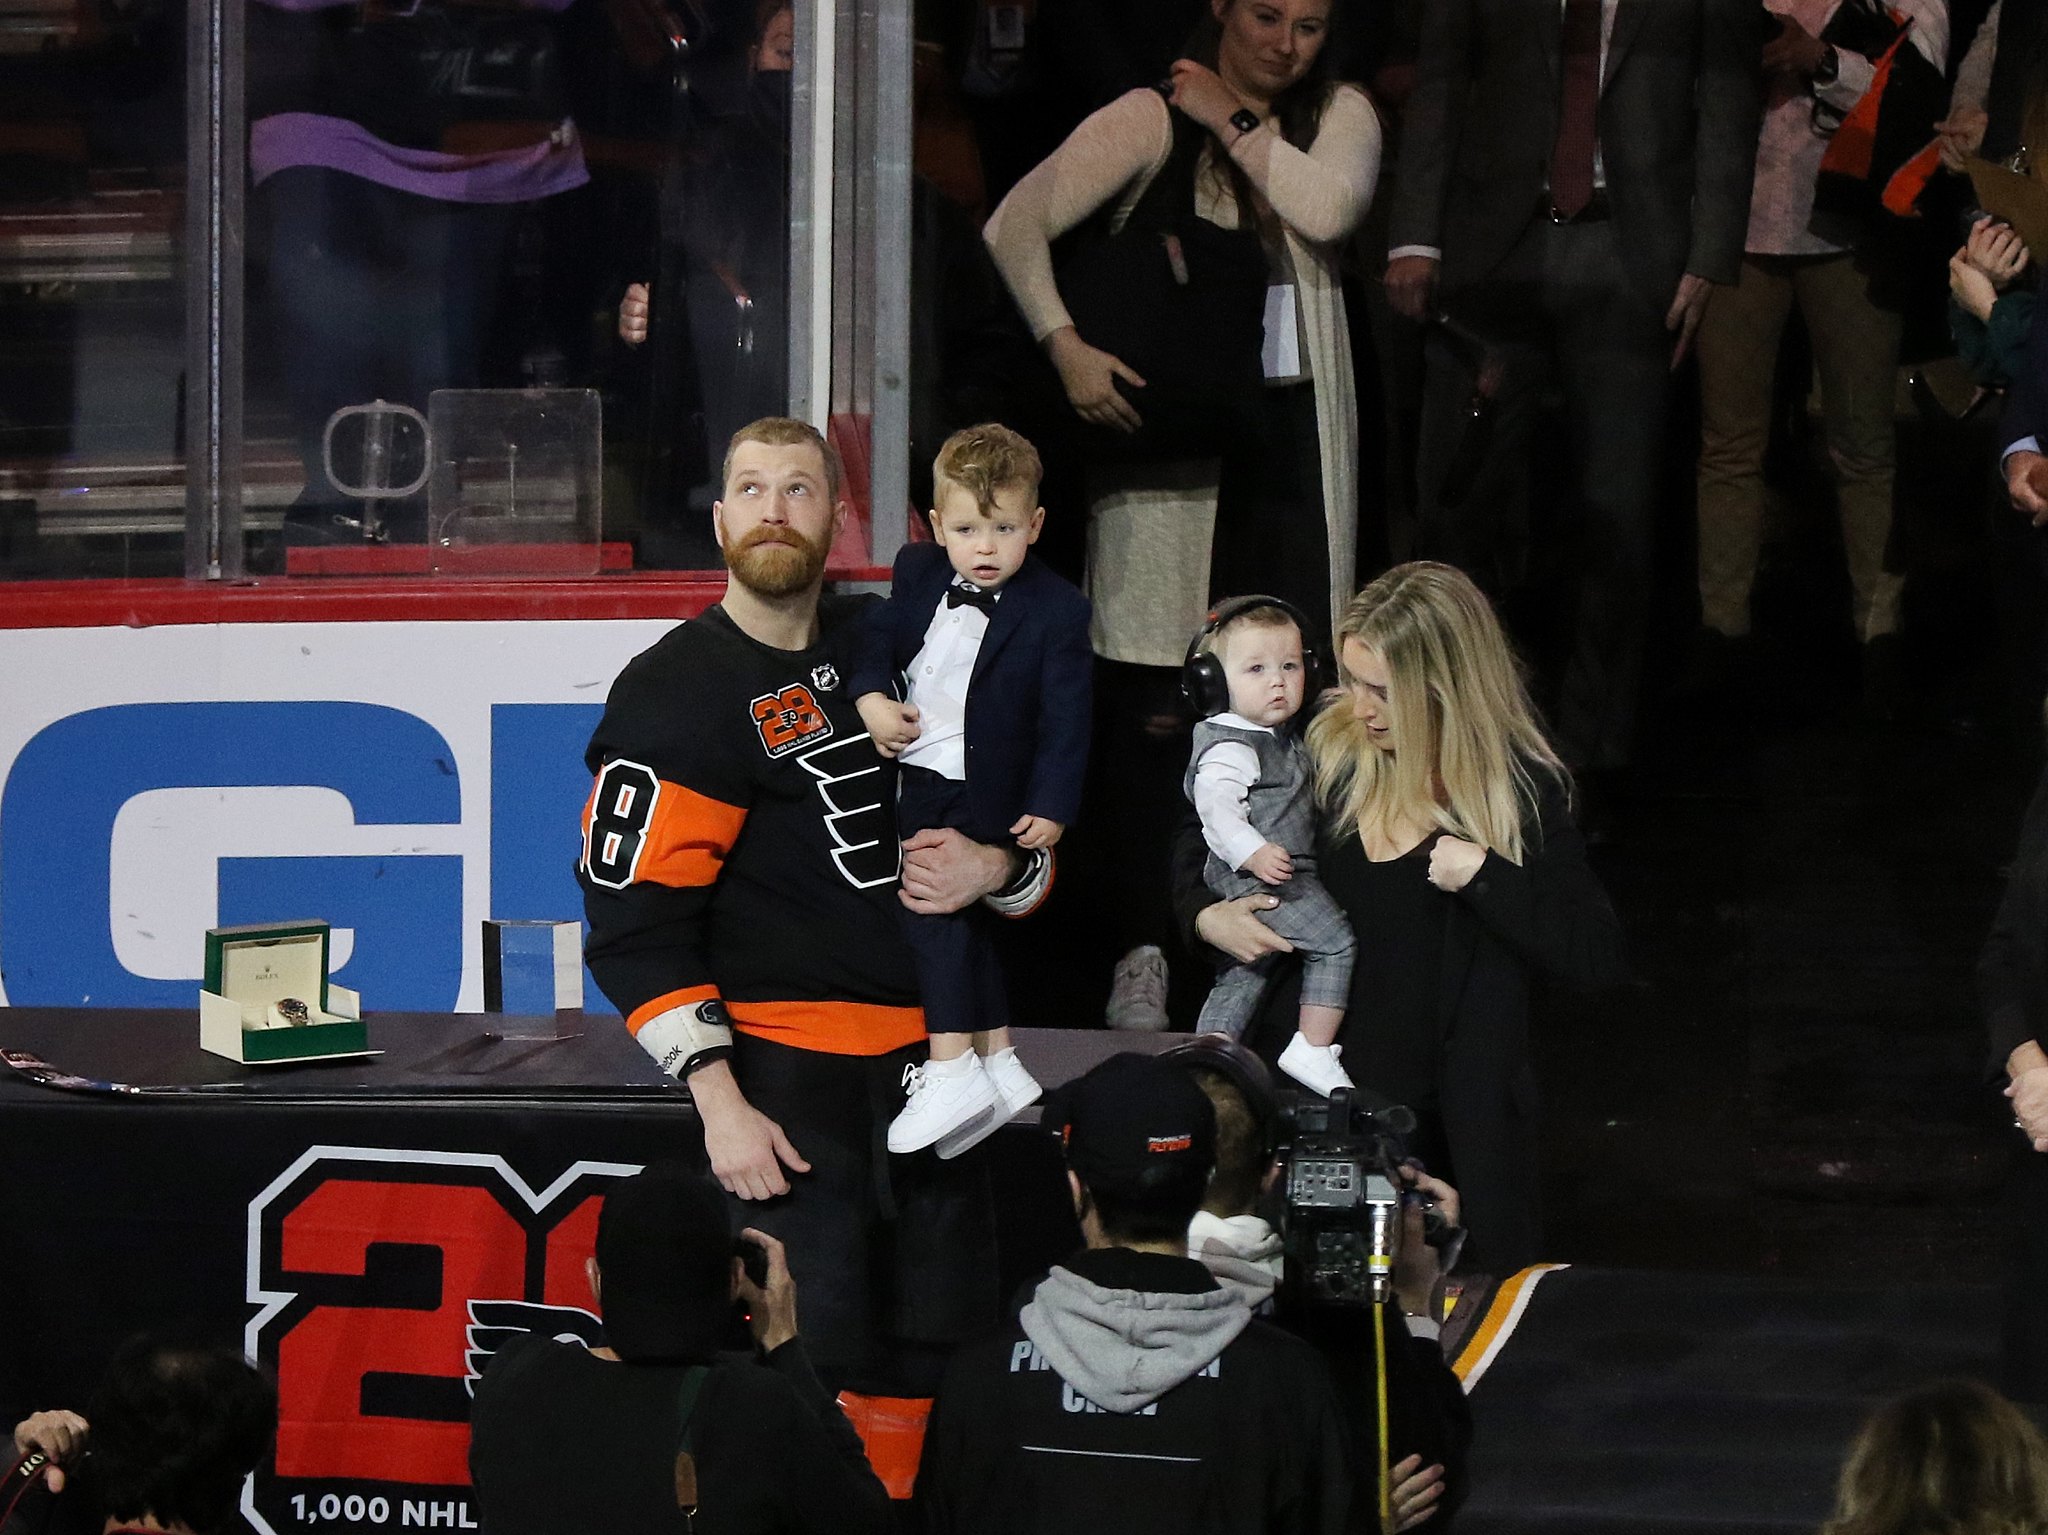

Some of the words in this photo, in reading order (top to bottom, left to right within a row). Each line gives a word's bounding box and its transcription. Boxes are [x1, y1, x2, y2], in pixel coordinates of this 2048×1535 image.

[752, 686, 826, 750] 28
[580, 758, 661, 890] 8
[290, 1493, 390, 1525] 1,000
[401, 1499, 479, 1529] NHL
